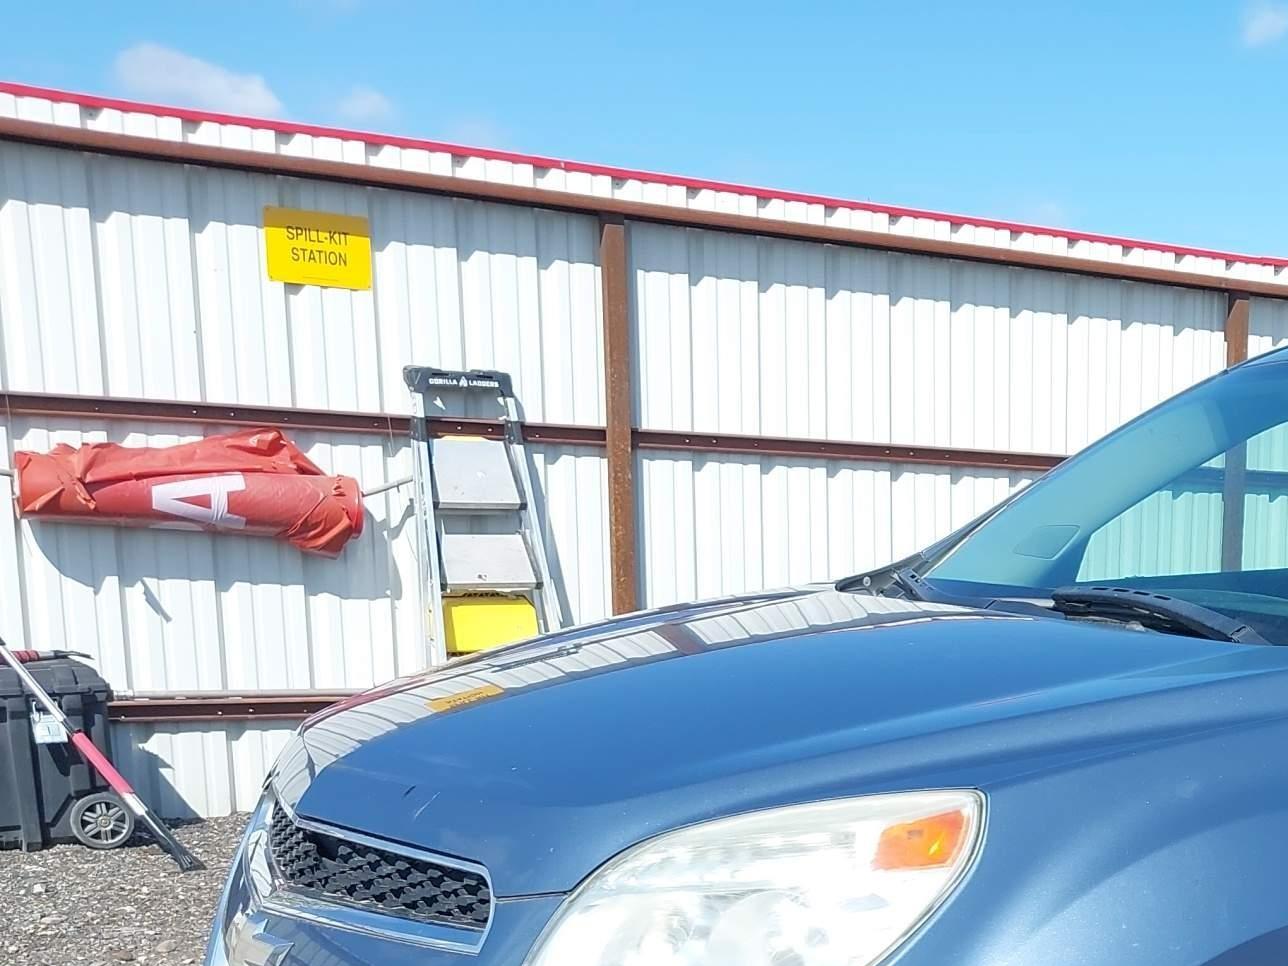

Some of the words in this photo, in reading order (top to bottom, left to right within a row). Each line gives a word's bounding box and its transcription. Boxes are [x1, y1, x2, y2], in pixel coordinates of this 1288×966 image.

[286, 225, 350, 246] SPILL-KIT
[291, 246, 348, 267] STATION
[428, 377, 458, 386] GORILLA
[468, 380, 500, 388] LADDERS
